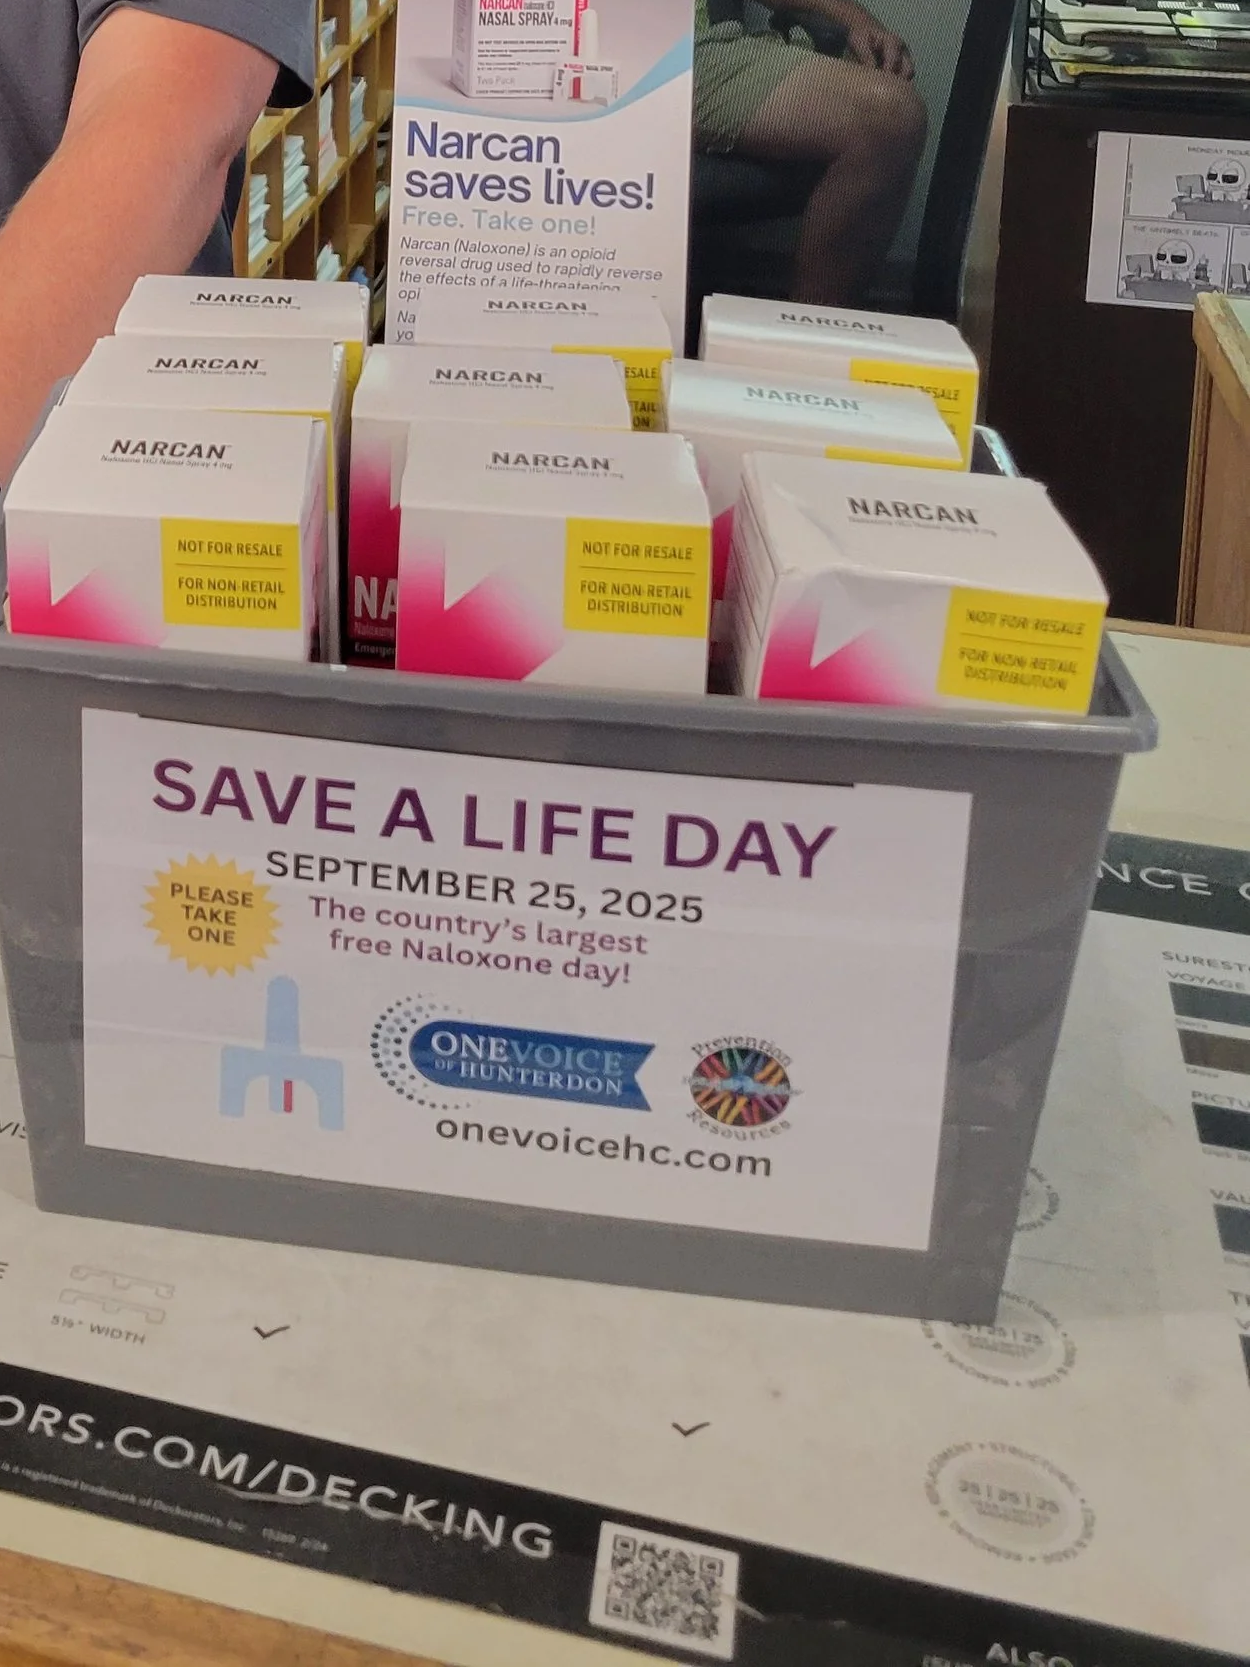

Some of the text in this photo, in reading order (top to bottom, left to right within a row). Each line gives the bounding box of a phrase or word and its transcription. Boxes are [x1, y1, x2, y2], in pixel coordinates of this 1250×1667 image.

[479, 12, 515, 26] NASAL
[518, 12, 554, 26] SPRAY
[406, 120, 560, 164] Narcan
[404, 168, 654, 210] saves lives!
[402, 205, 596, 235] Free. Take one!
[400, 237, 616, 263] Narcan (Naloxone) is an opioid
[399, 255, 663, 281] reversal drug used to rapidly reverse
[399, 270, 621, 292] the effects of a life-threatening
[196, 293, 292, 305] NARCAN
[487, 300, 587, 311] NARCAN
[780, 312, 885, 332] NARCAN
[154, 358, 260, 370] NARCAN
[435, 368, 542, 383] NARCAN
[746, 386, 861, 411] NARCAN
[110, 439, 227, 459] NARCAN
[491, 451, 610, 470] NARCAN
[848, 496, 979, 525] NARCAN
[177, 539, 283, 557] NOT FOR RESALE
[582, 541, 693, 560] NOT FOR RESALE
[178, 577, 285, 594] FOR NON-RETAIL
[580, 580, 693, 600] FOR NON-RETAIL
[186, 595, 277, 610] DISTRIBUTION
[587, 599, 684, 617] DISTRIBUTION
[966, 608, 1086, 636] NOT FOR RESALE
[959, 646, 987, 664] FOR
[963, 664, 1068, 691] DISTRIBUTION
[152, 757, 839, 879] SAVE A LIFE DAY
[171, 882, 254, 909] PLEASE
[265, 849, 704, 924] SEPTEMBER 25, 2025
[181, 904, 237, 926] TAKE
[308, 894, 648, 955] The country’s largest
[187, 926, 236, 947] ONE
[328, 927, 632, 988] free Naloxone day!
[1167, 970, 1246, 990] VOYAGE
[430, 1030, 625, 1076] ONEVOICE
[691, 1036, 792, 1068] Prevention
[459, 1061, 624, 1096] HUNTERDON
[686, 1107, 791, 1141] Resources
[435, 1117, 772, 1177] onevoicehc.com
[88, 1323, 146, 1345] WIDTH
